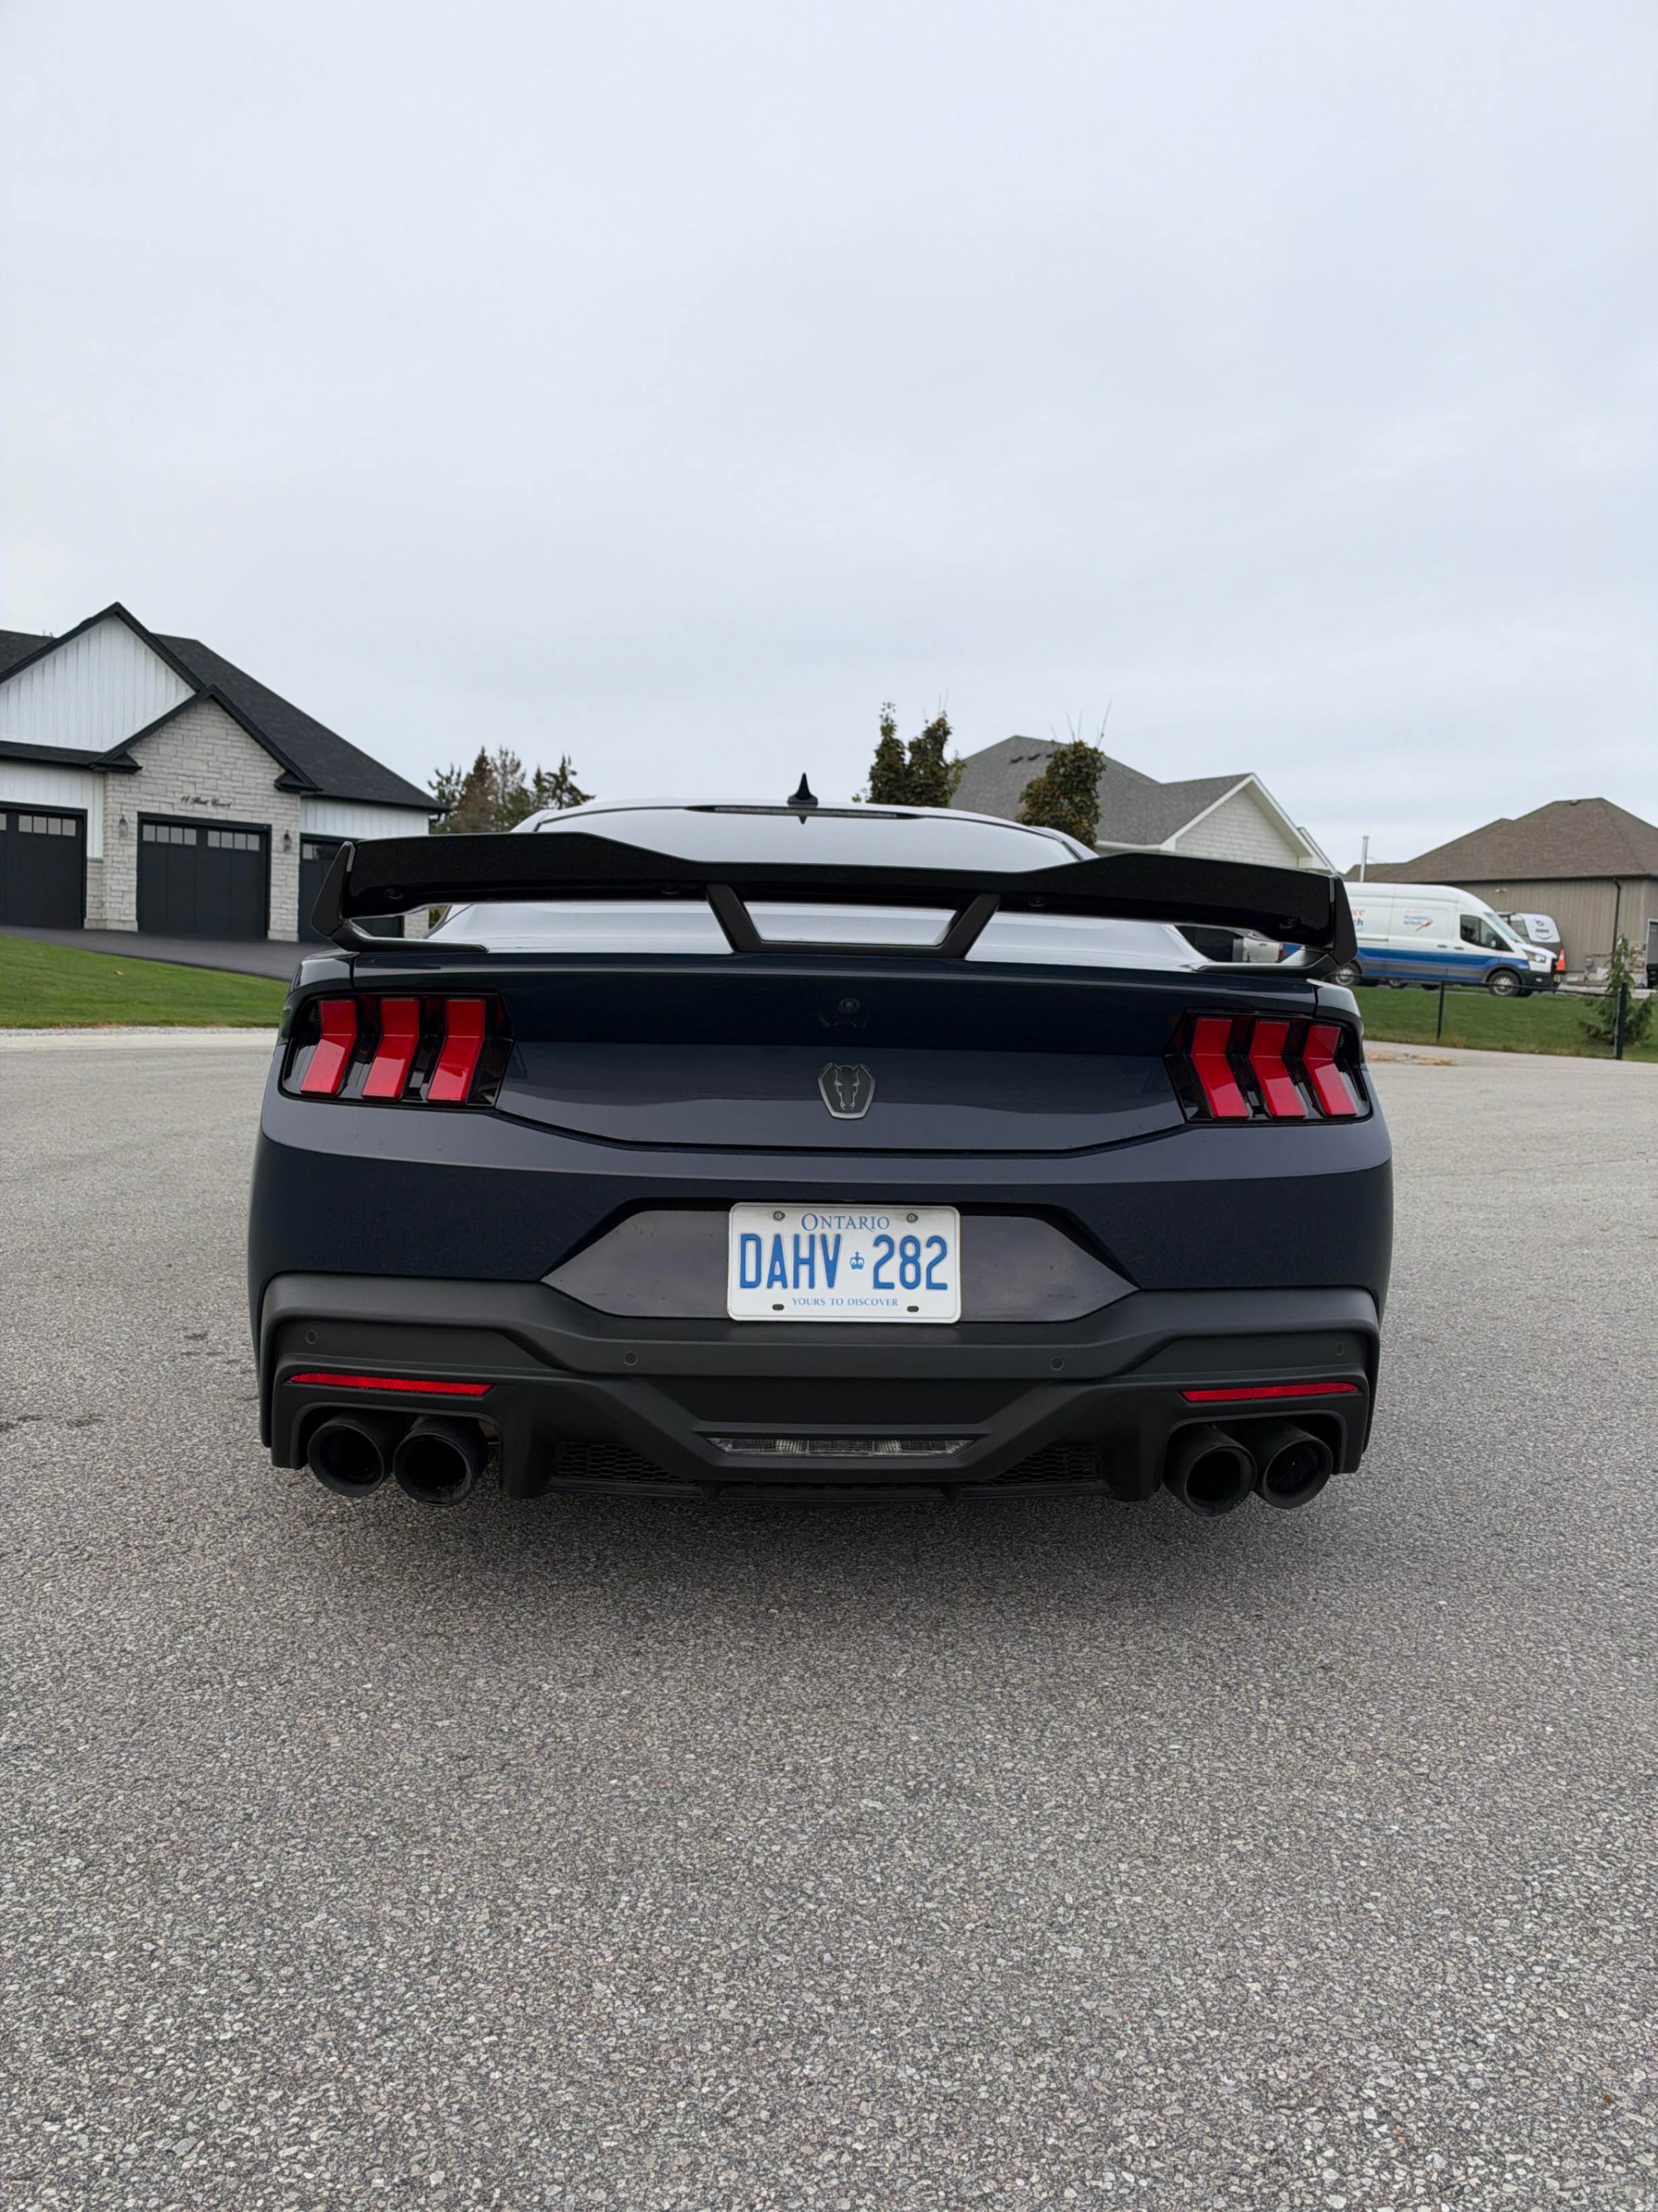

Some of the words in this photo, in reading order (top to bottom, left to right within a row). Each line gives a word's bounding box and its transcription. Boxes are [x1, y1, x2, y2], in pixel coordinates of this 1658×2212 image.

[739, 1234, 841, 1289] DAHV
[872, 1234, 948, 1290] 282
[792, 1297, 826, 1306] YOURS
[830, 1298, 844, 1306] TO
[847, 1298, 899, 1306] DISCOVER
